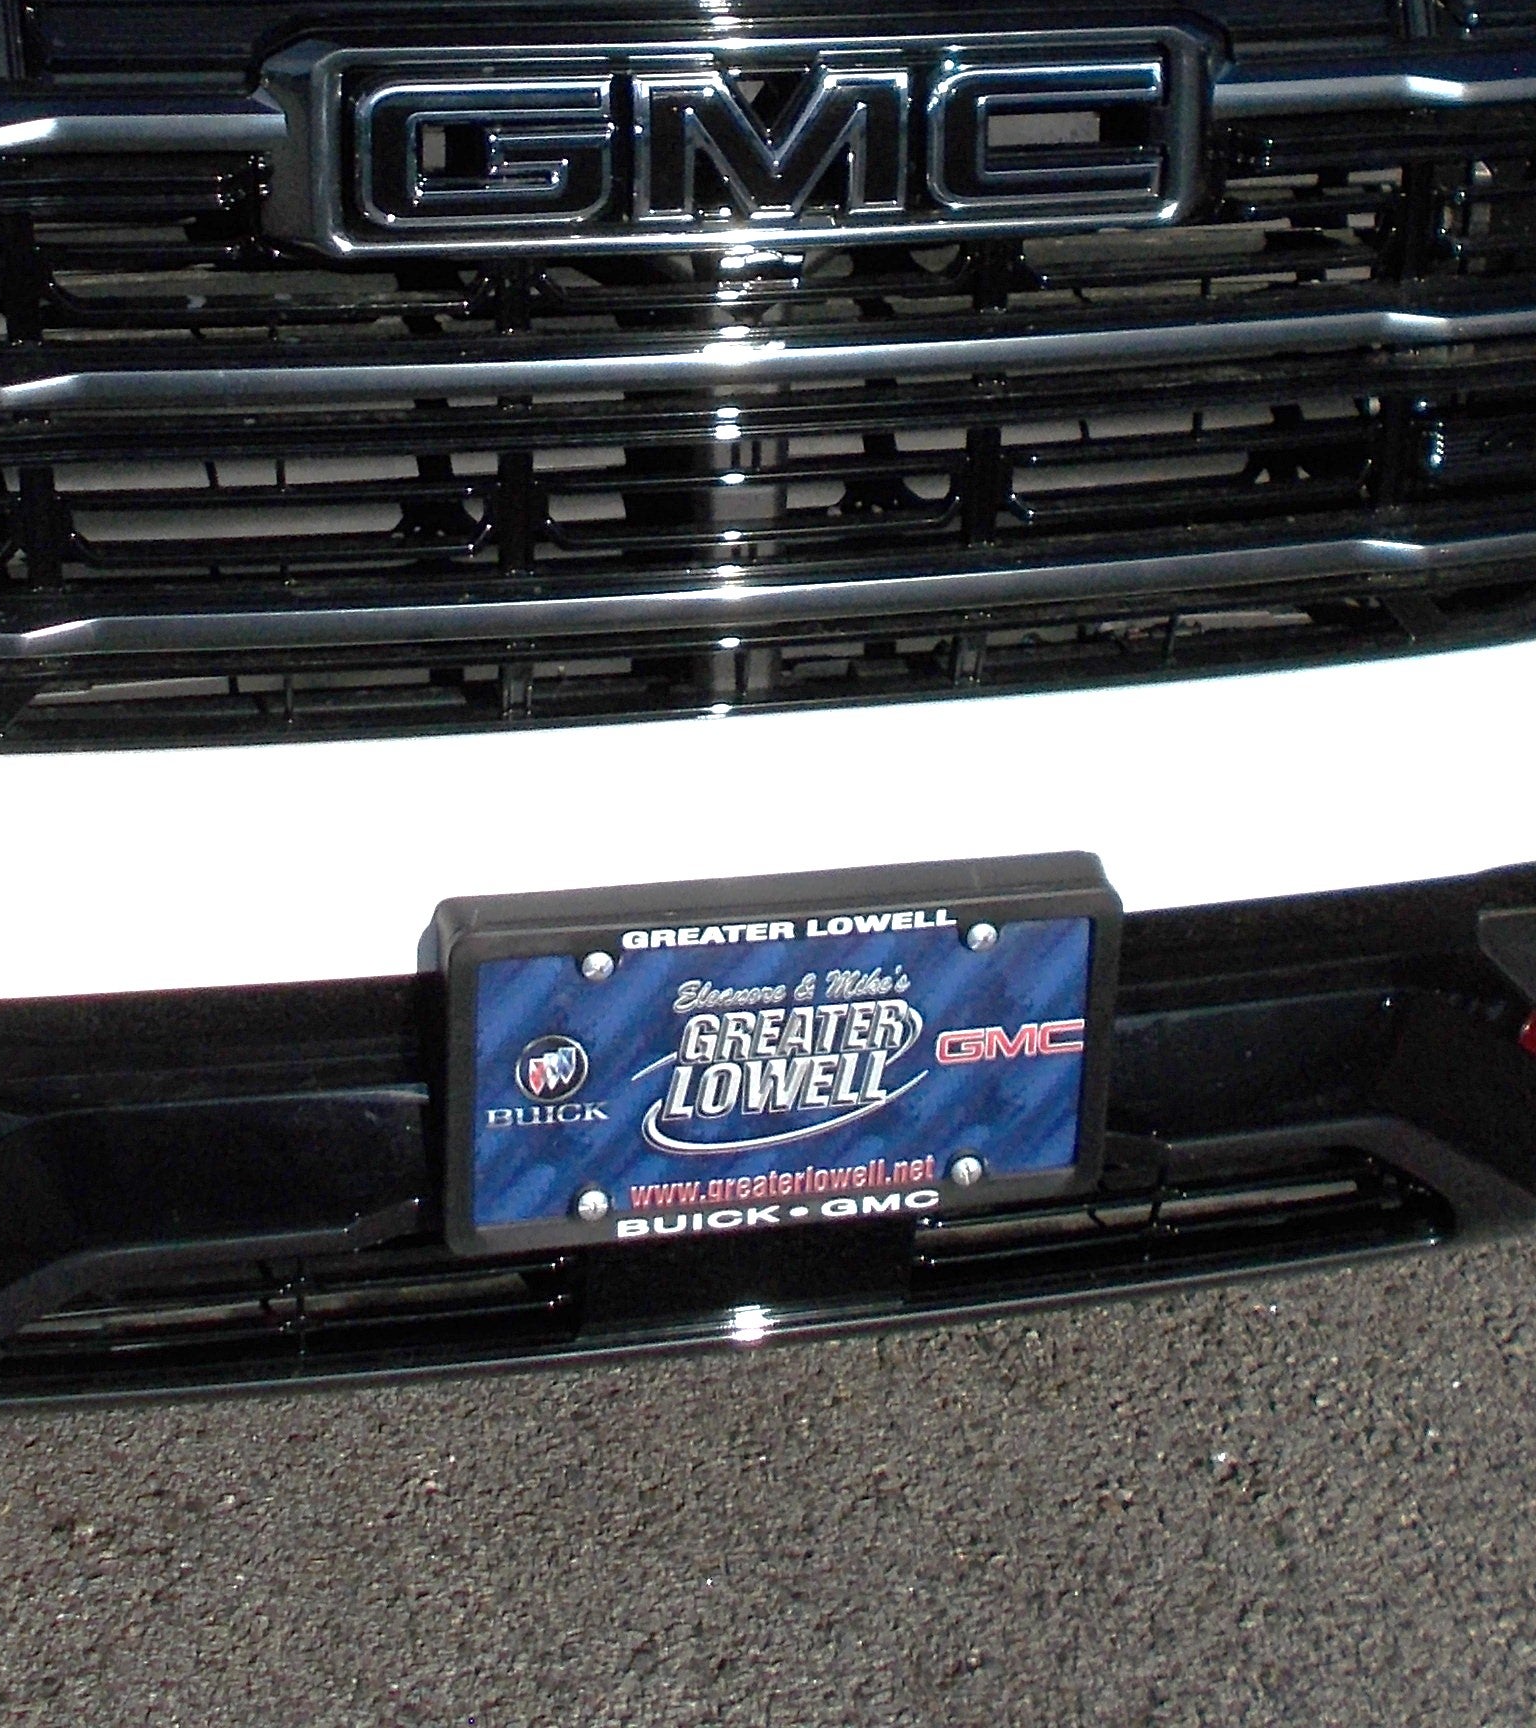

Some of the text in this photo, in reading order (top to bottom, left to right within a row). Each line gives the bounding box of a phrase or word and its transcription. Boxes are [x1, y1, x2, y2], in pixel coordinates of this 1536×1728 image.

[356, 60, 1170, 228] GMC
[622, 908, 958, 950] GREATER LOWELL
[793, 972, 817, 1002] &
[825, 964, 912, 1000] Mike's
[677, 998, 910, 1065] GREATER
[935, 1018, 1085, 1066] GMC
[662, 1049, 888, 1122] LOWELL
[485, 1101, 611, 1129] BUICK
[630, 1154, 935, 1209] www.greaterlowell.net
[616, 1189, 940, 1239] BUICK GMC
